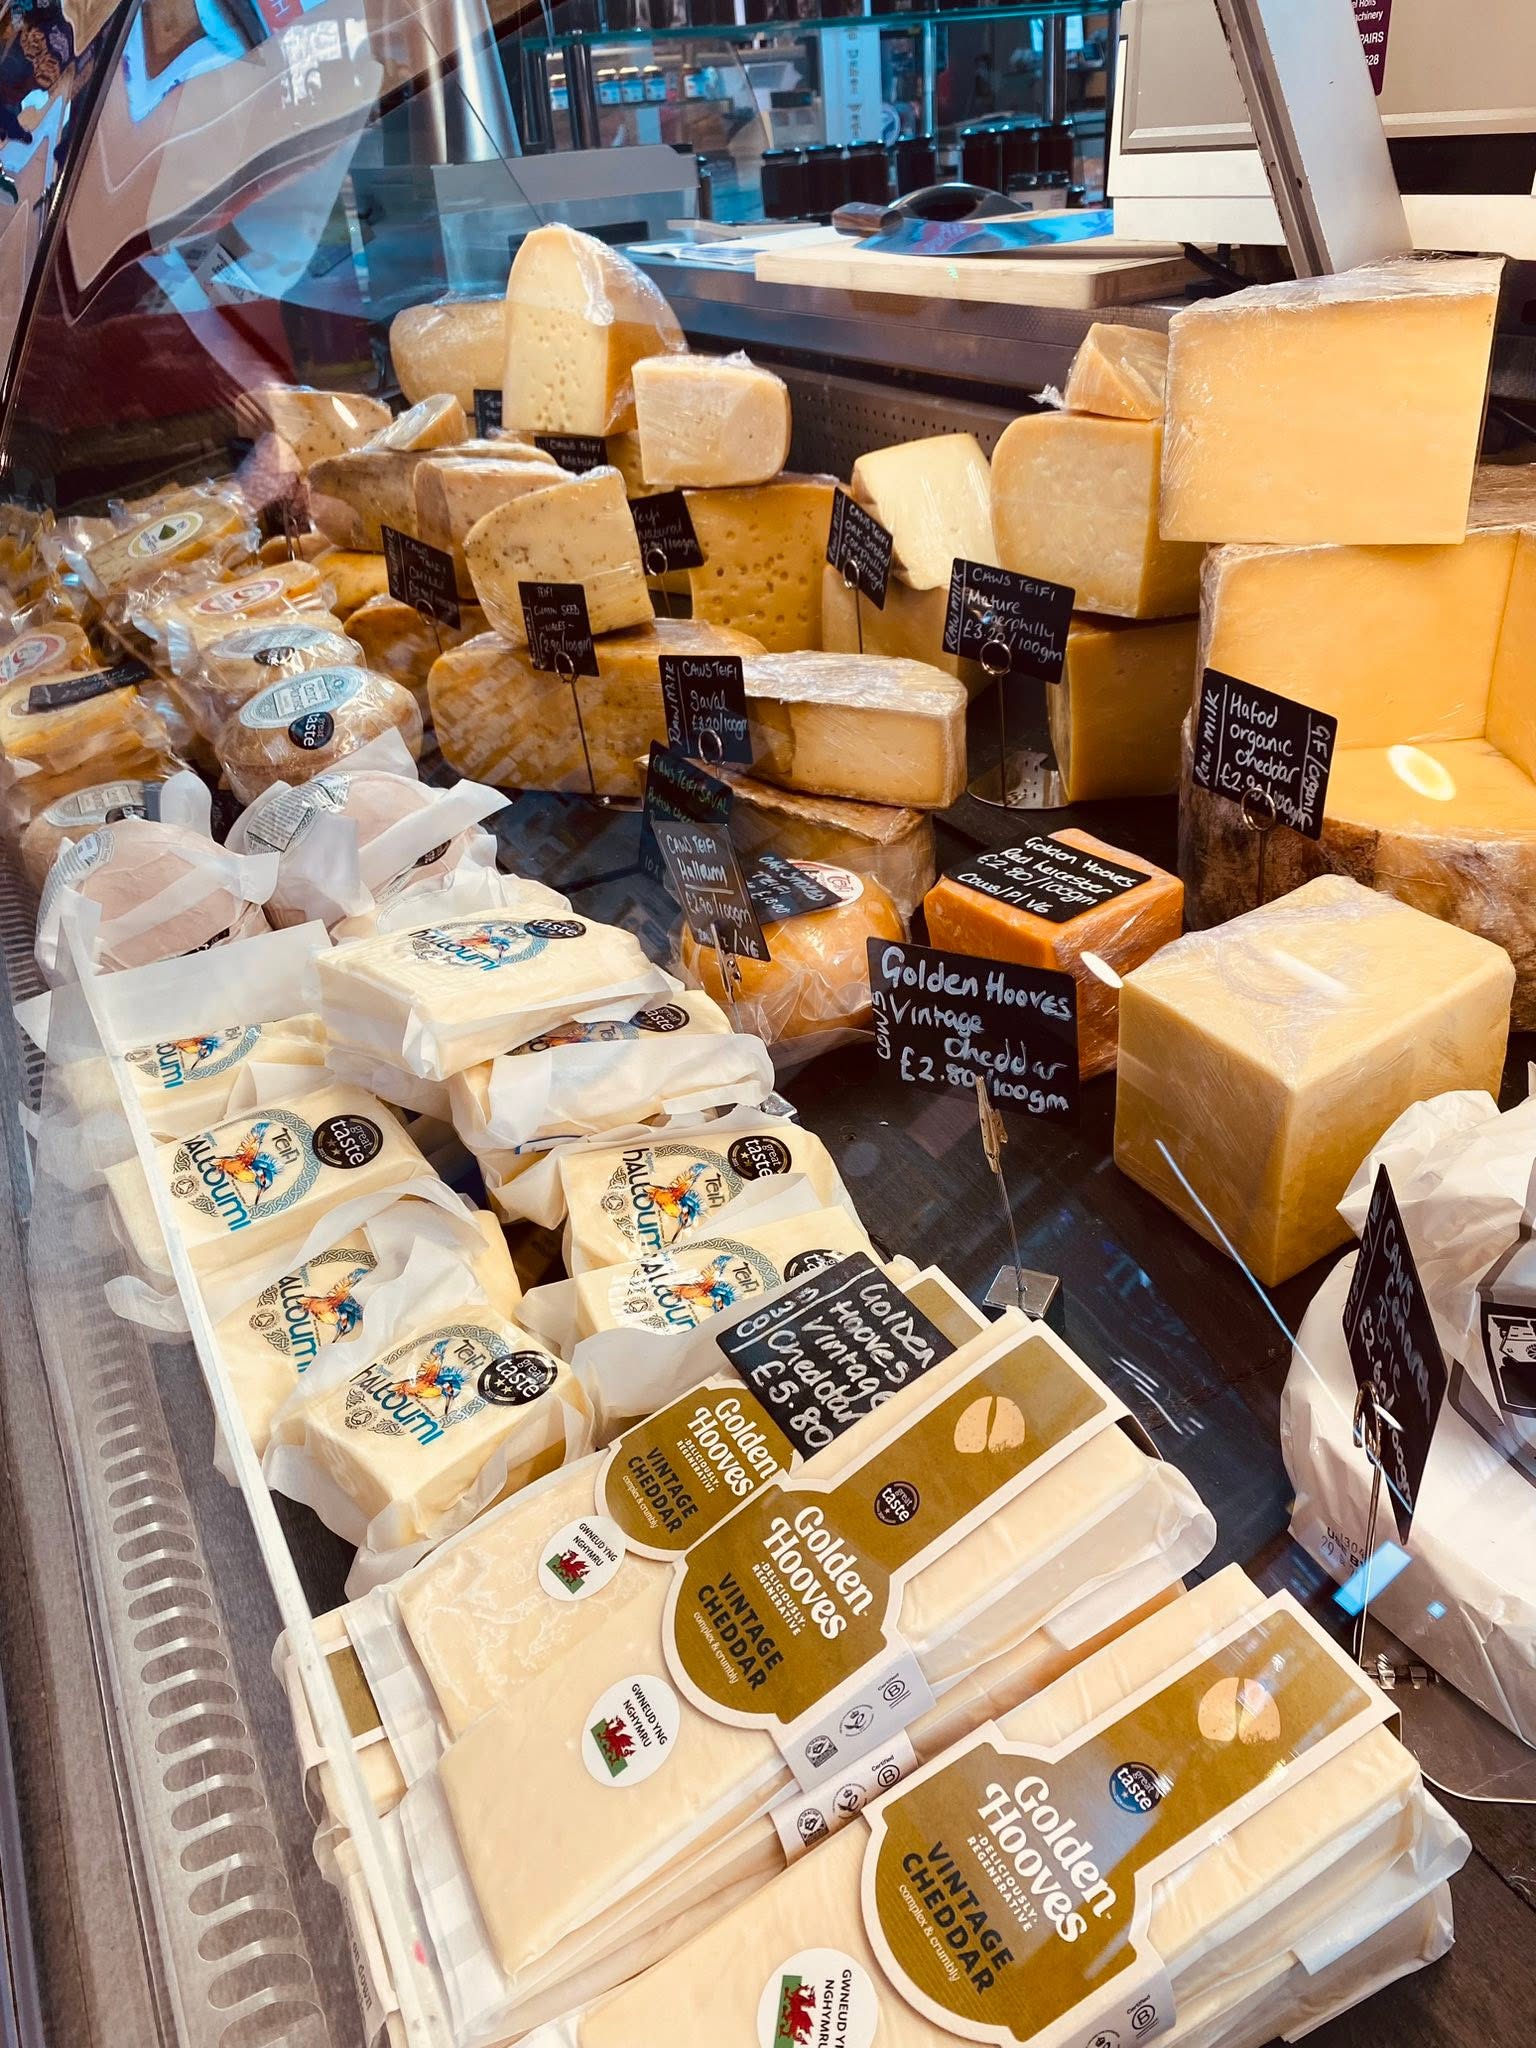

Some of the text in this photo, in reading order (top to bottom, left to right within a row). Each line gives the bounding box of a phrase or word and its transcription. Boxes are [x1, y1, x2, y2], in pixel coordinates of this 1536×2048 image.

[964, 588, 1021, 615] Mature
[972, 567, 1056, 602] CAWS TEIFI
[1229, 692, 1279, 729] Hafod
[1230, 724, 1294, 757] organic
[1000, 847, 1035, 865] Red
[1024, 836, 1138, 888] Golden Hooves
[881, 946, 1073, 1022] Golden Hooves
[890, 993, 985, 1039] Vintage
[329, 1119, 365, 1166] taste
[349, 1125, 373, 1149] great
[744, 1138, 773, 1178] taste
[761, 1143, 782, 1167] great
[495, 1358, 540, 1398] taste
[516, 1358, 546, 1383] great
[687, 1406, 755, 1497] Hooves
[714, 1397, 779, 1480] Golden
[646, 1446, 700, 1520] VINTAGE
[676, 1440, 716, 1495] REGENERATIVE
[627, 1455, 684, 1535] CHEDDAR
[881, 1487, 910, 1521] taste
[572, 1535, 604, 1568] NGHYMRU
[578, 1522, 618, 1563] GWNEUD YNG
[794, 1505, 873, 1617] Golden
[751, 1564, 801, 1638] REGENERATIVE
[762, 1516, 848, 1640] Hooves
[693, 1611, 717, 1647] complex
[715, 1650, 740, 1686] crumbly
[697, 1583, 769, 1693] CHEDDAR
[717, 1572, 785, 1673] VINTAGE
[622, 1699, 652, 1749] NGHYMRU
[631, 1682, 668, 1747] GWNEUD YNG
[871, 1754, 895, 1773] Certified
[1117, 1767, 1152, 1811] taste
[1132, 1770, 1155, 1794] great
[978, 1782, 1088, 1944] Hooves
[1014, 1775, 1117, 1920] Golden
[927, 1841, 1015, 1974] VINTAGE
[967, 1836, 1033, 1934] REGENERATIVE
[899, 1884, 961, 1983] complex & crumbly
[902, 1852, 996, 1997] CHEDDAR
[836, 1968, 853, 2032] GWNEUD
